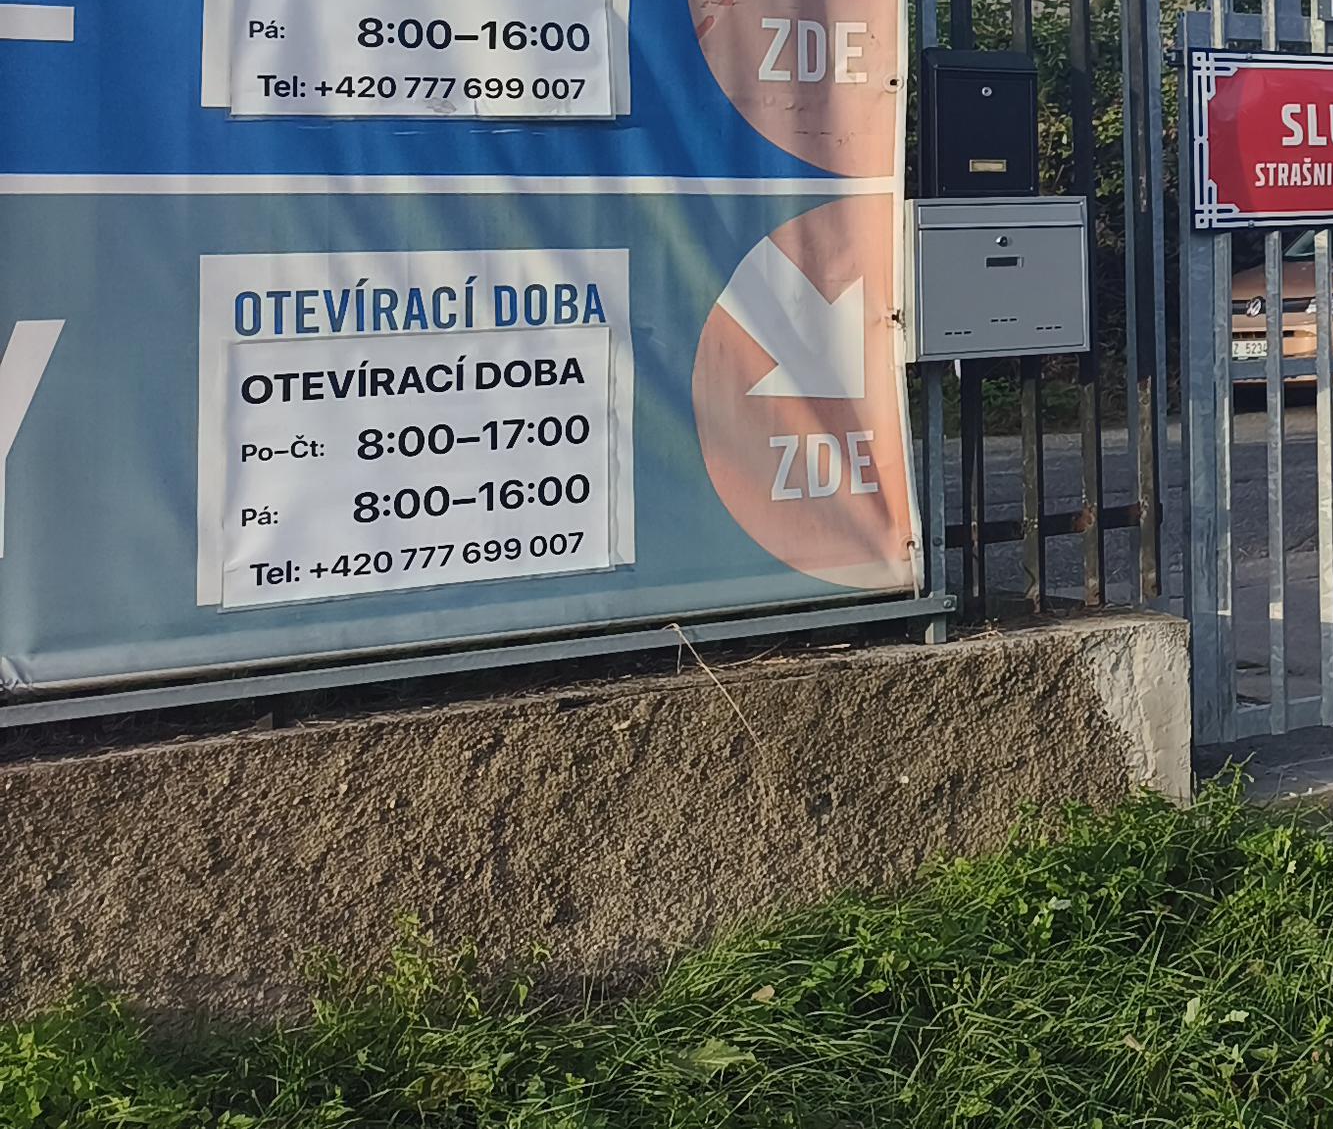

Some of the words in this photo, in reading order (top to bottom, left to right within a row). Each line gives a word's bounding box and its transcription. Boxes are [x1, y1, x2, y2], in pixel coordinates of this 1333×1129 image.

[248, 20, 286, 40] Pá:
[758, 17, 868, 84] ZDE
[257, 75, 306, 98] Tel:
[314, 76, 397, 99] +420
[404, 77, 456, 99] 777
[463, 78, 525, 100] 699
[532, 79, 586, 100] 007
[234, 275, 478, 337] OTEVÍRACÍ
[494, 283, 607, 327] DOBA
[241, 355, 468, 405] OTEVÍRACÍ
[475, 357, 585, 390] DOBA
[769, 430, 880, 502] ZDE
[241, 506, 279, 527] Pá:
[250, 561, 300, 587] Tel:
[310, 551, 393, 580] +420
[400, 544, 455, 571] 777
[462, 538, 523, 565] 699
[529, 531, 584, 558] 007
